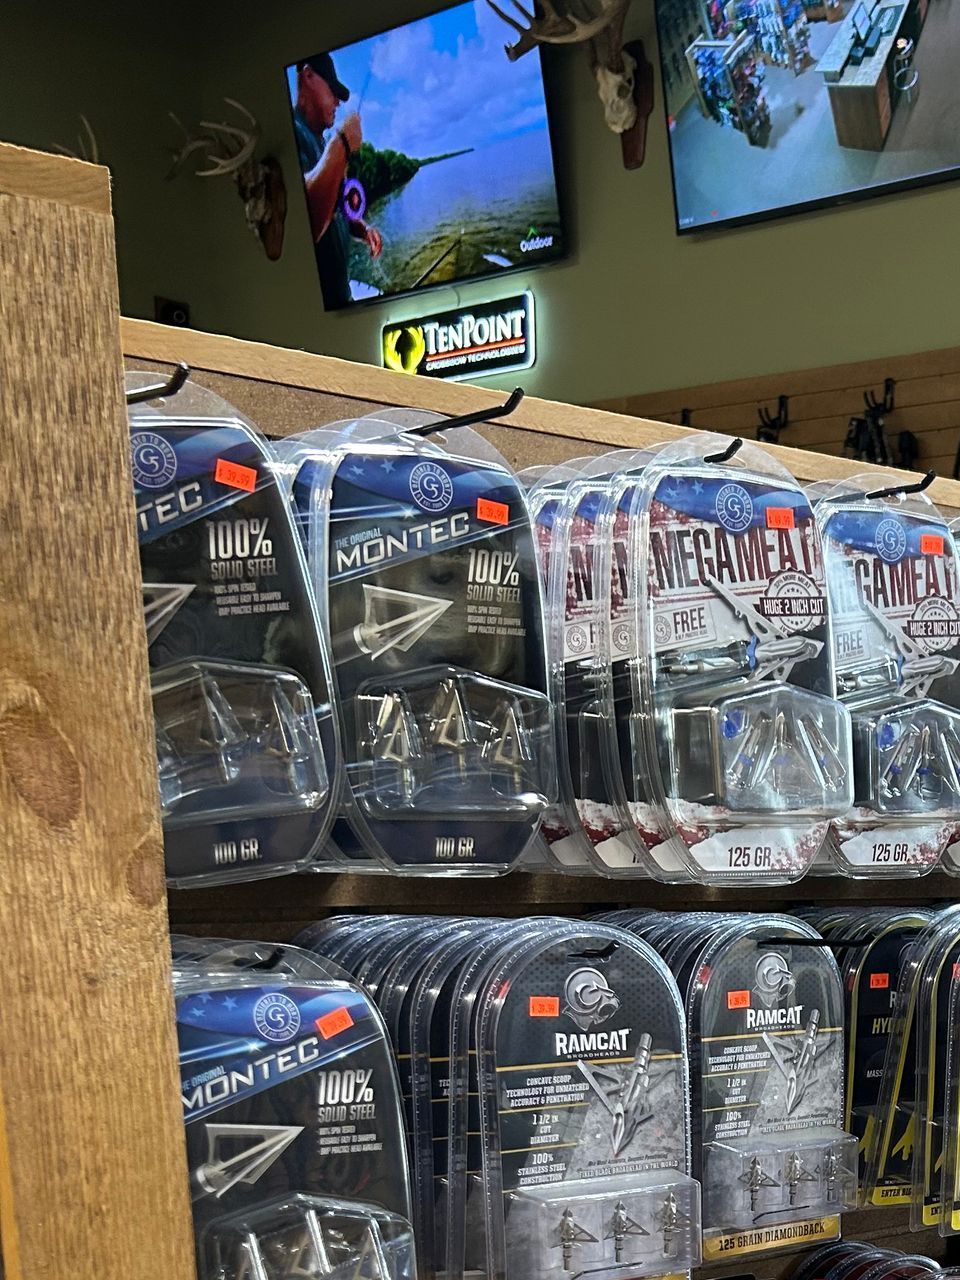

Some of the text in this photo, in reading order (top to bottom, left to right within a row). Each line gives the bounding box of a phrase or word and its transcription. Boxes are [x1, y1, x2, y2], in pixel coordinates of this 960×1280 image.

[520, 236, 553, 252] Outdoor
[206, 517, 272, 560] 100%
[335, 527, 382, 549] THE ORIGINAL
[336, 512, 470, 572] MONTEC
[655, 519, 815, 590] MEGAMEAT
[210, 557, 278, 580] SOLID STEEL
[467, 548, 520, 586] 100%
[466, 586, 520, 603] SOLID STEEL
[764, 599, 783, 615] HUGE
[791, 599, 808, 614] INCH
[810, 598, 824, 614] CUT
[673, 606, 706, 635] FREE
[910, 621, 926, 635] HUGE
[933, 621, 948, 635] INCH
[949, 620, 960, 635] CUT
[836, 631, 863, 653] FREE
[213, 838, 262, 864] 100 GR.
[435, 837, 476, 860] 100 GR.
[872, 844, 911, 862] 125 GR.
[747, 1005, 804, 1029] RAMCAT
[555, 1028, 632, 1056] RAMCAT
[566, 1051, 620, 1060] BROADHEADS
[181, 1037, 320, 1110] MONTEC
[526, 1075, 571, 1086] CONCAVE SCOOP
[318, 1068, 374, 1105] 100%
[506, 1082, 589, 1098] TECHNOLOGY FOR UNMATCHED
[510, 1096, 540, 1107] ACCURACY
[546, 1092, 584, 1104] PENETRATION
[318, 1103, 376, 1123] SOLID STEEL
[540, 1125, 551, 1134] CUT
[714, 1122, 738, 1131] STAINLESS
[530, 1134, 559, 1145] DIAMETER
[532, 1153, 553, 1164] 100%
[518, 1162, 566, 1176] STAINLESS STEEL
[520, 1173, 563, 1185] CONSTRUCTION
[719, 1222, 825, 1252] 125 GRAIN DIAMONDBACK
